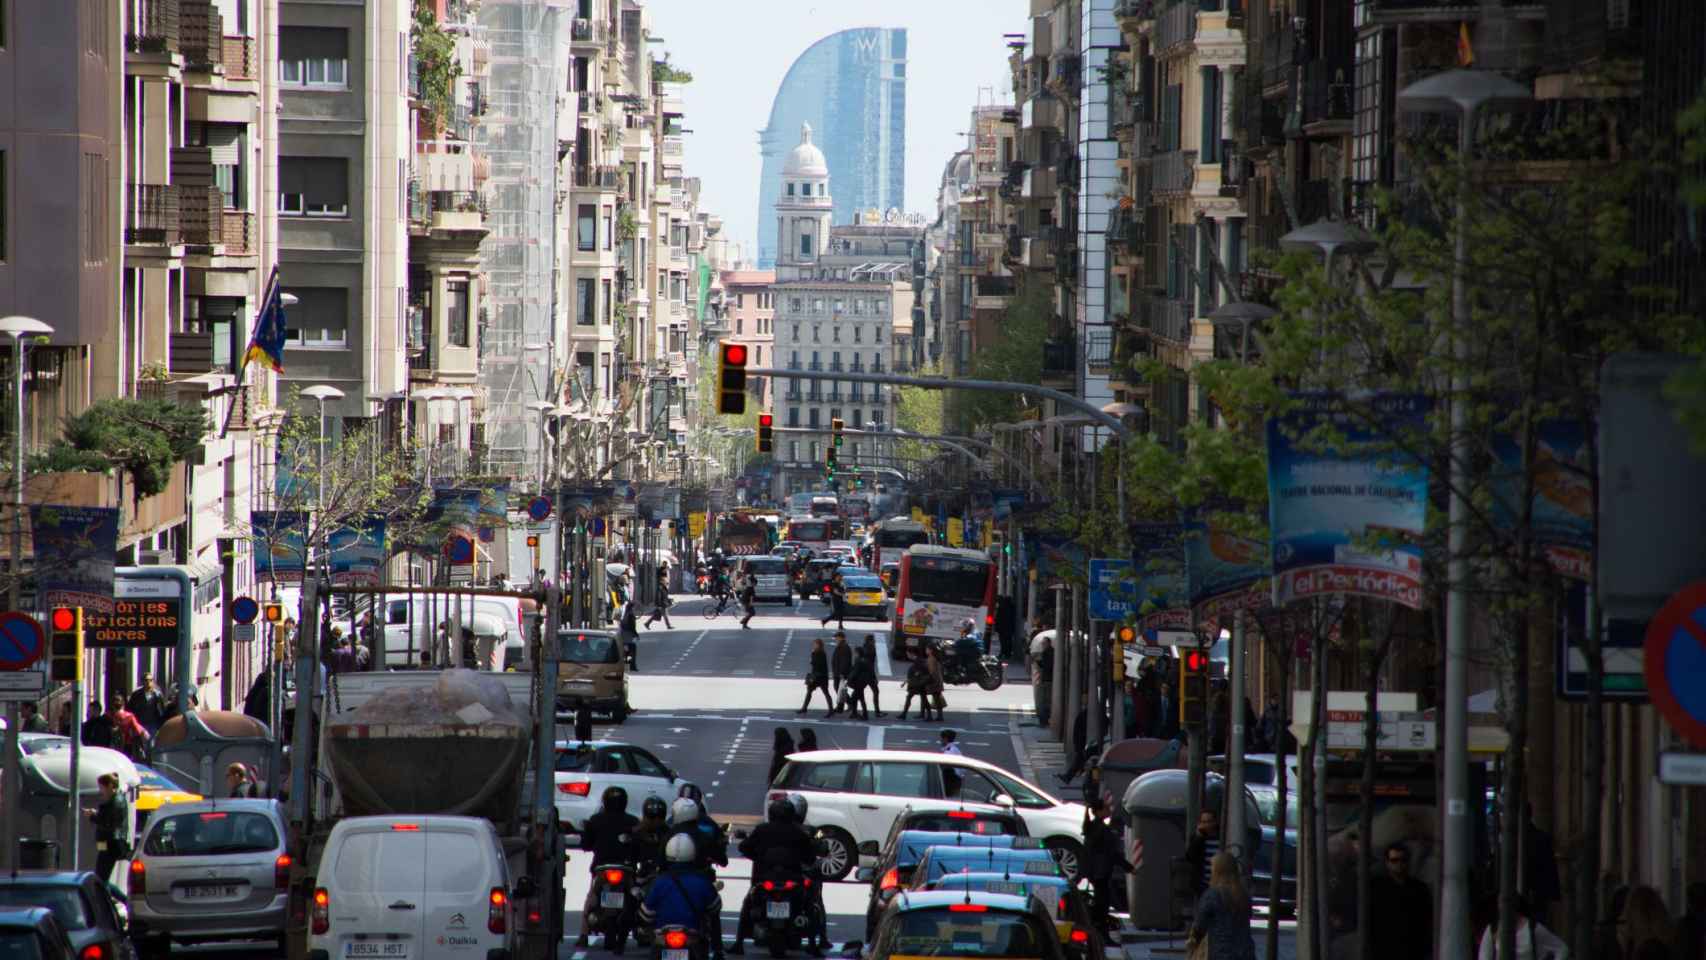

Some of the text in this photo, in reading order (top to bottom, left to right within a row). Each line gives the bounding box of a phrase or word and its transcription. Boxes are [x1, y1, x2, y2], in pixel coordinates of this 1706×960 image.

[856, 36, 878, 51] W
[1310, 485, 1351, 497] NACIONAL
[1295, 568, 1419, 602] el Periódico
[82, 614, 177, 627] triccions
[96, 628, 146, 641] obres
